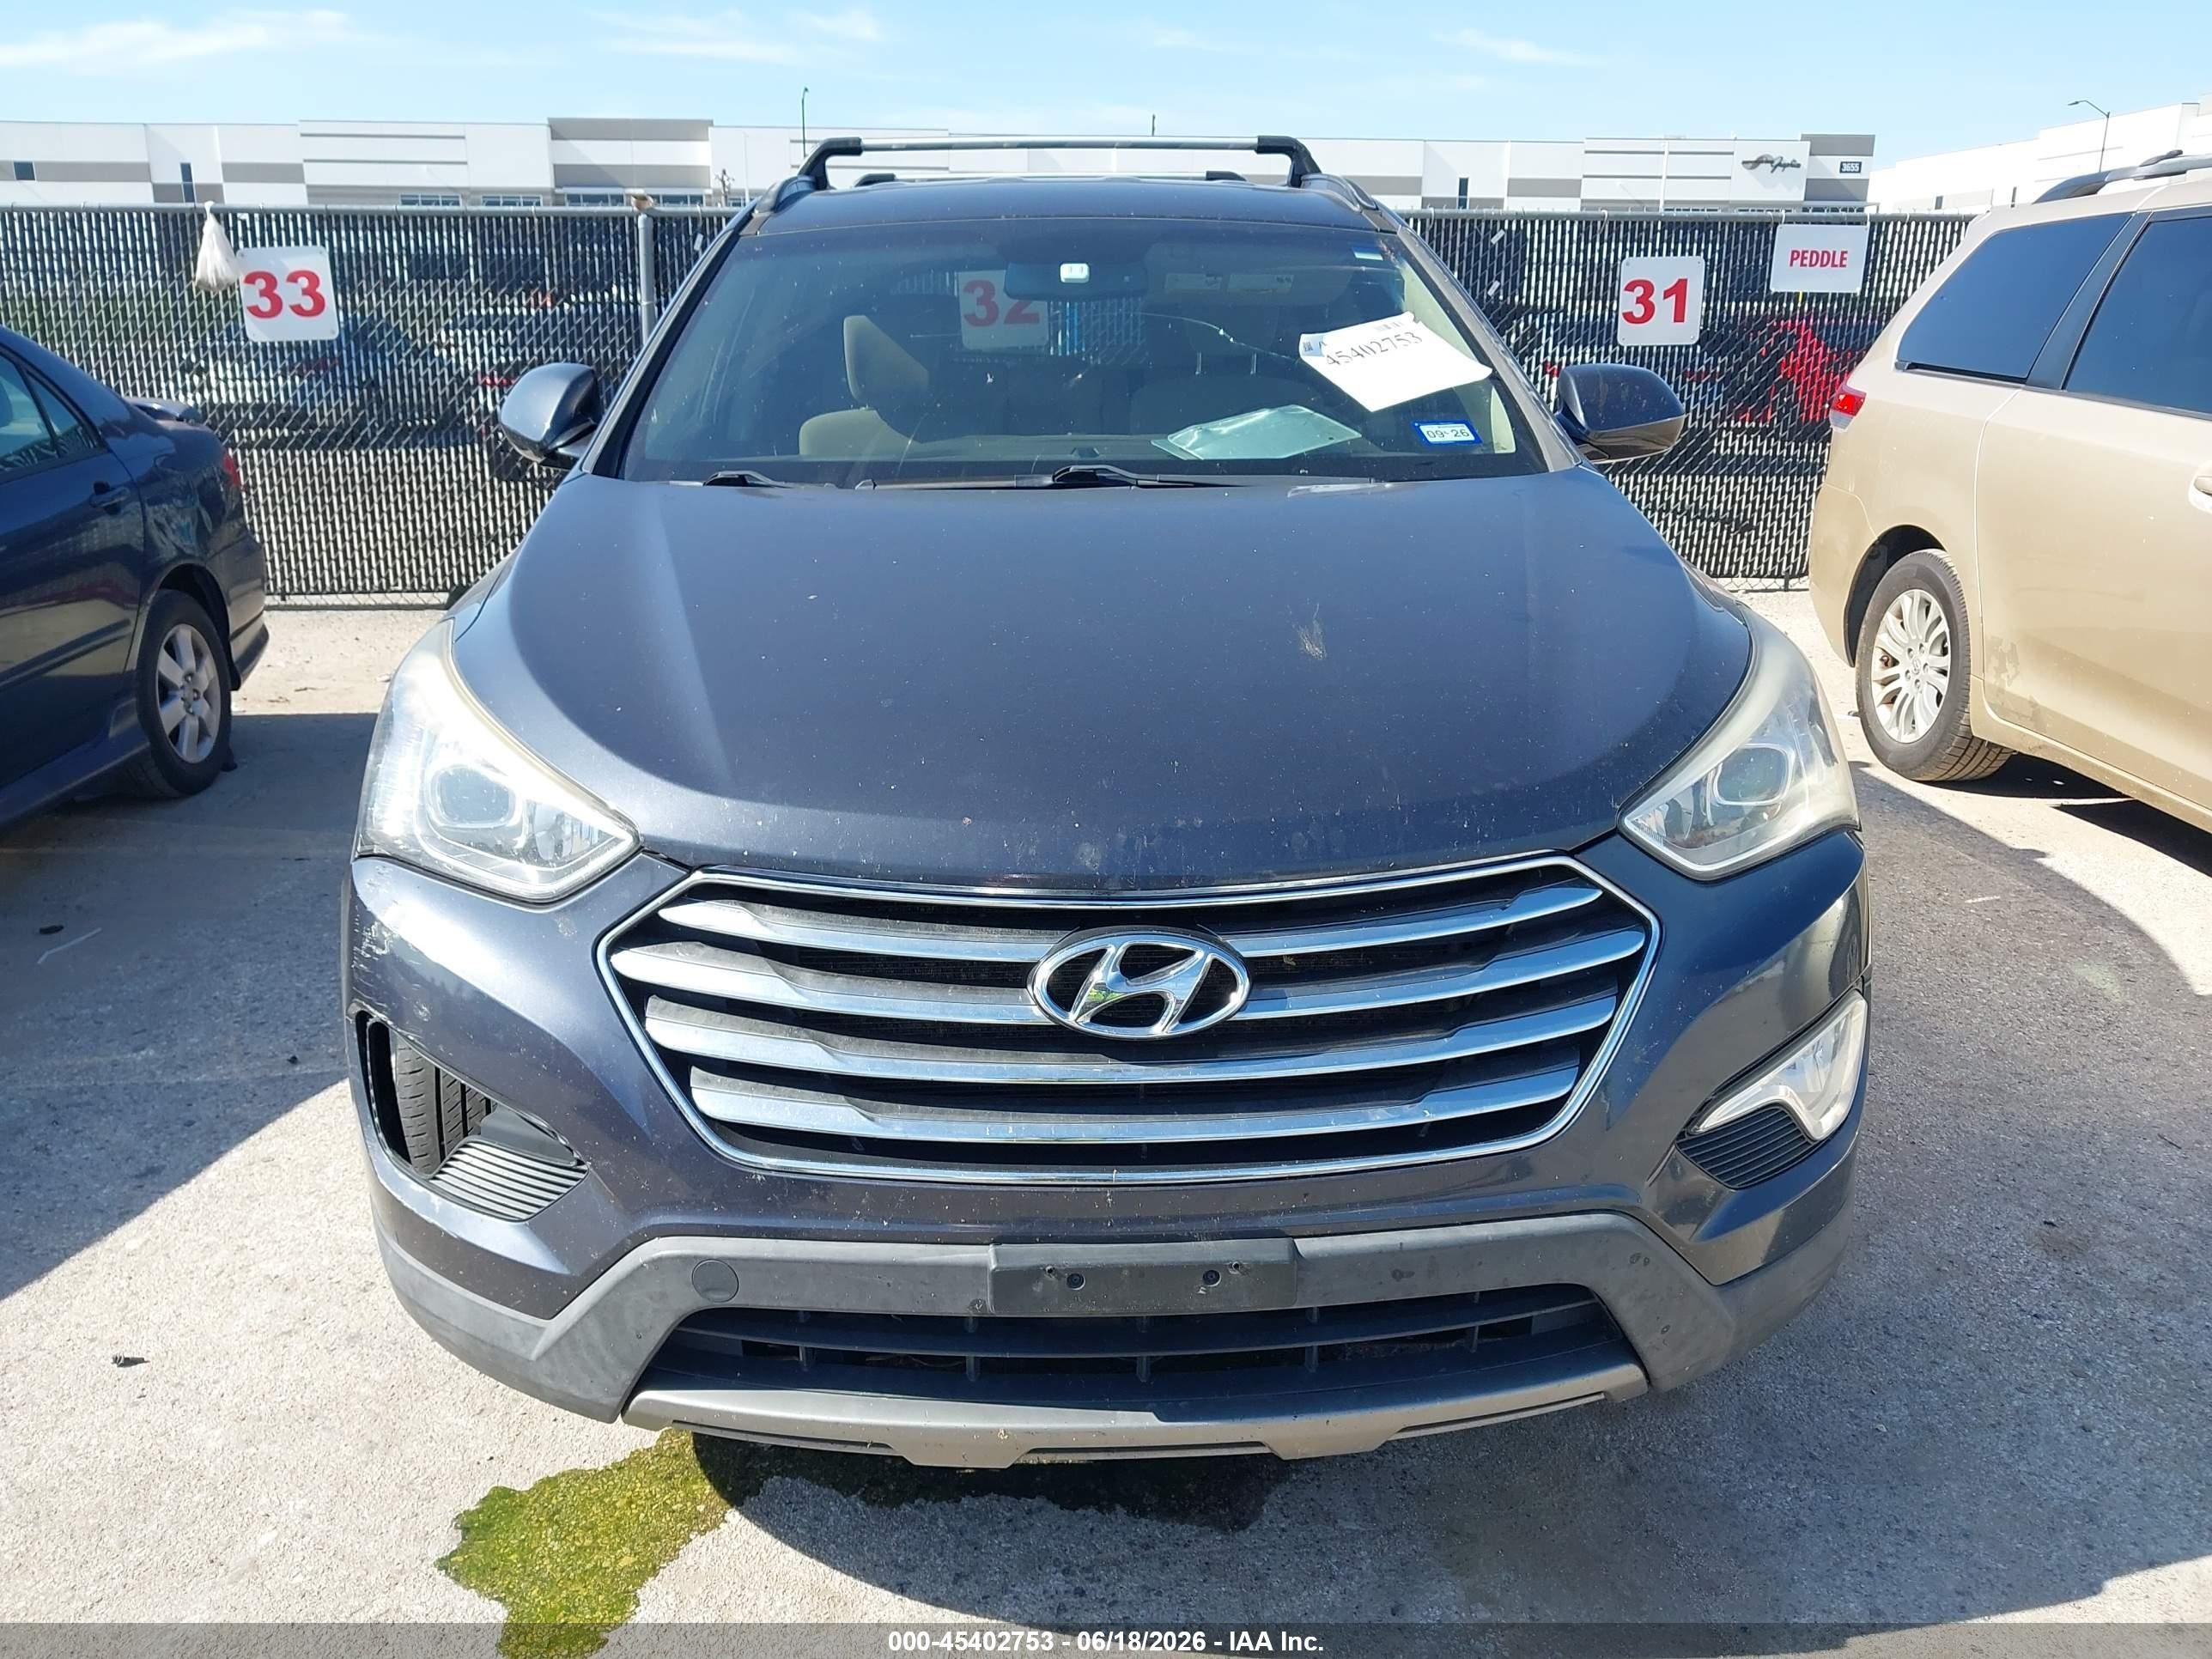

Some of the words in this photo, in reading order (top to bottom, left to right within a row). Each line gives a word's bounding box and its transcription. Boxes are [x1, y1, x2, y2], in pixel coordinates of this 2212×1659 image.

[1841, 162, 1860, 173] 3655
[1789, 250, 1848, 268] PEDDLE
[243, 269, 325, 319] 33
[1621, 278, 1688, 325] 31
